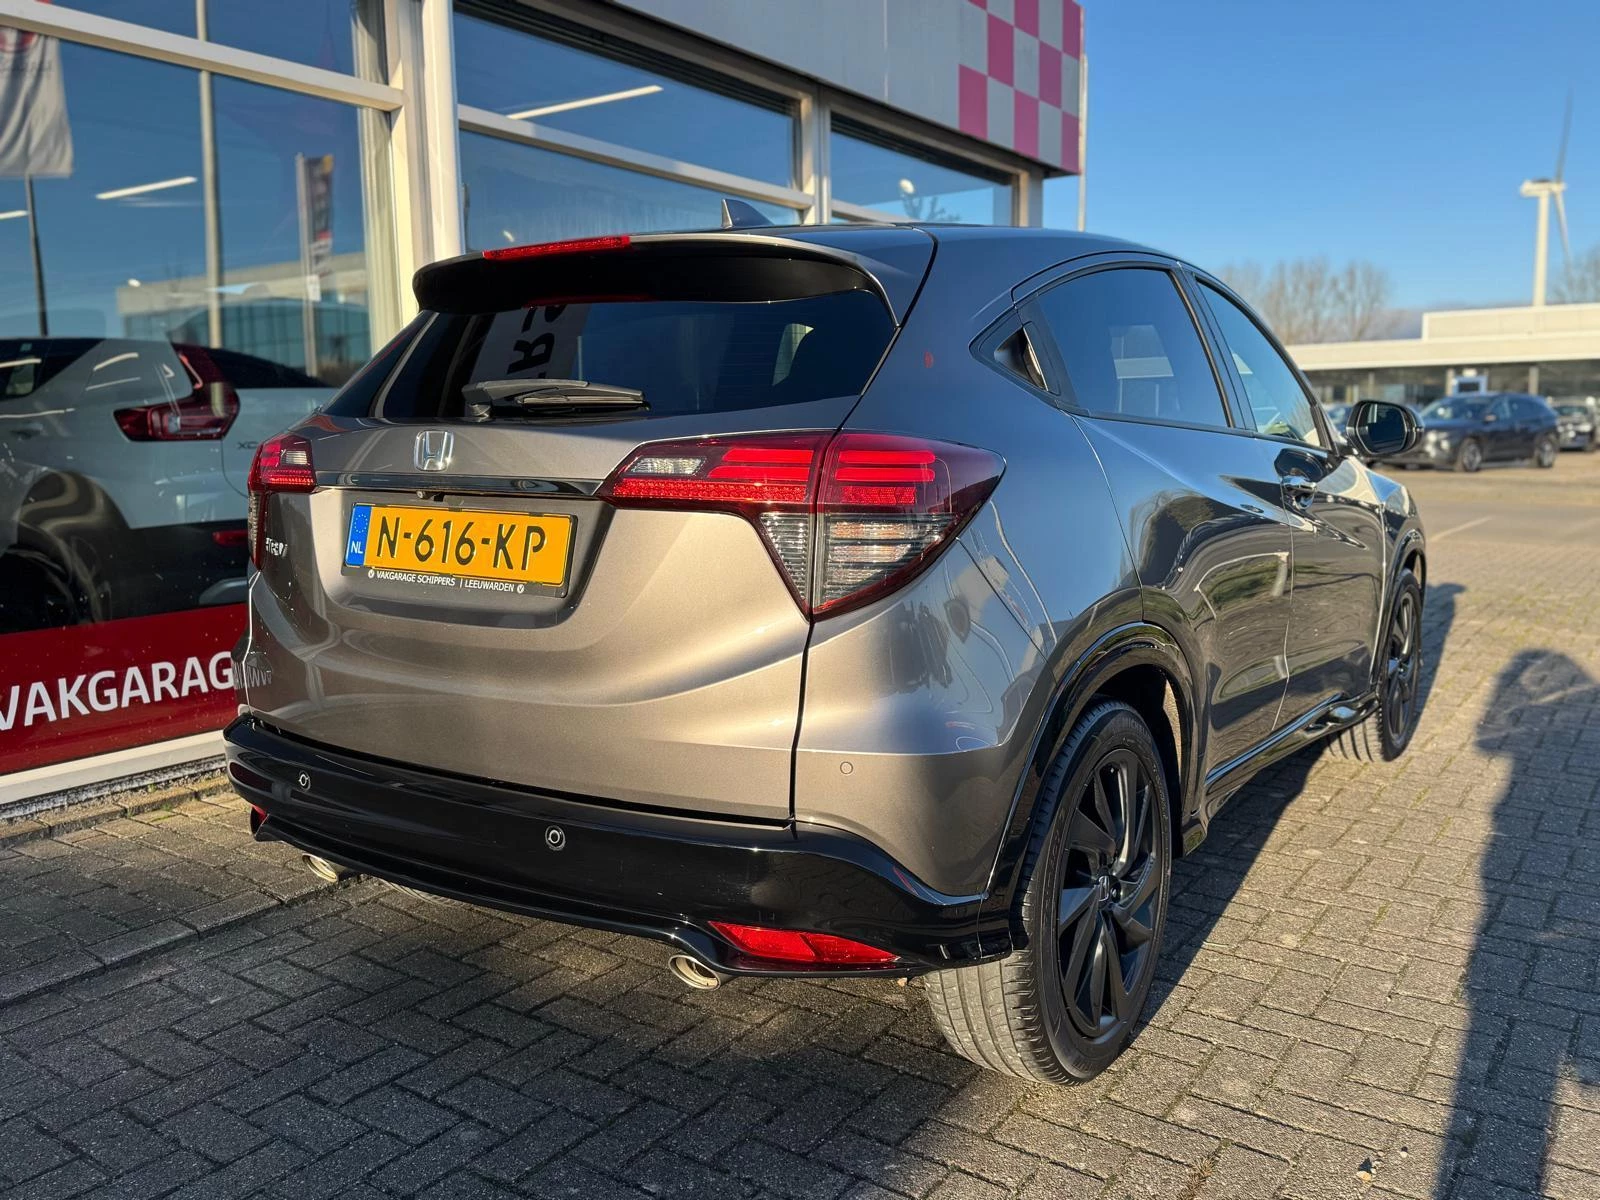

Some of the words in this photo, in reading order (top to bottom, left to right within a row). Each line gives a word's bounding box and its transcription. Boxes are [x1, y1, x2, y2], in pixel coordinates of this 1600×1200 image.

[350, 541, 364, 555] NL
[376, 516, 546, 571] N-616-KP
[376, 570, 416, 583] VAKGARAGE
[417, 574, 456, 587] SCHIPPERS
[465, 579, 515, 592] LEEUWARDEN
